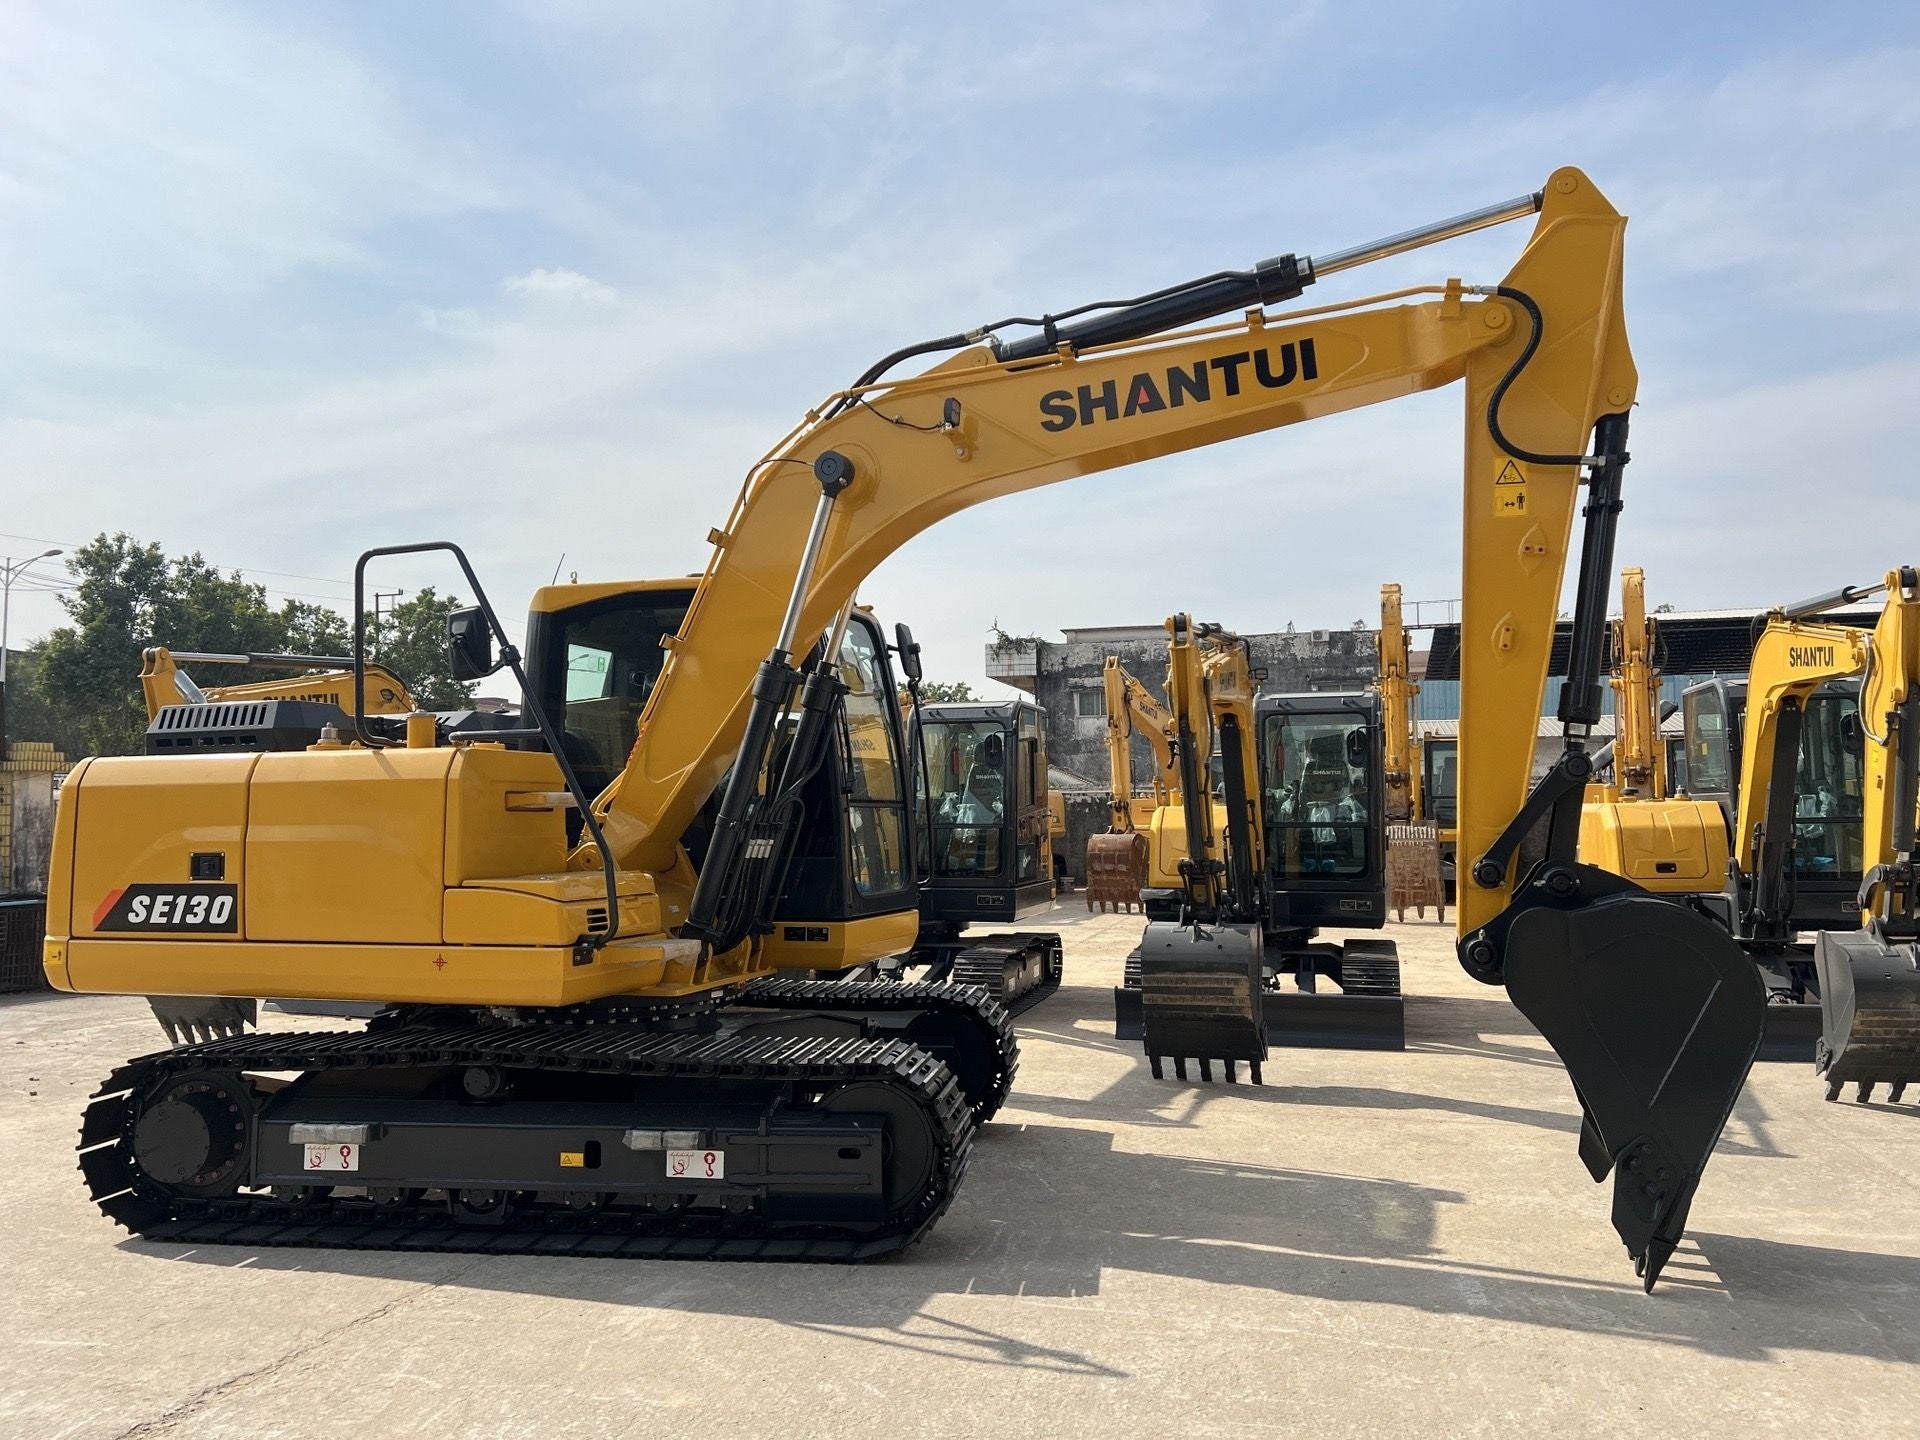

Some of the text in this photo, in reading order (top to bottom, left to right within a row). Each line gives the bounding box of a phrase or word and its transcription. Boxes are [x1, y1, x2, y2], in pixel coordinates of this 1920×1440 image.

[1039, 337, 1318, 432] SHANTUI
[1789, 646, 1834, 667] SHANTUI
[127, 895, 233, 924] SE130
